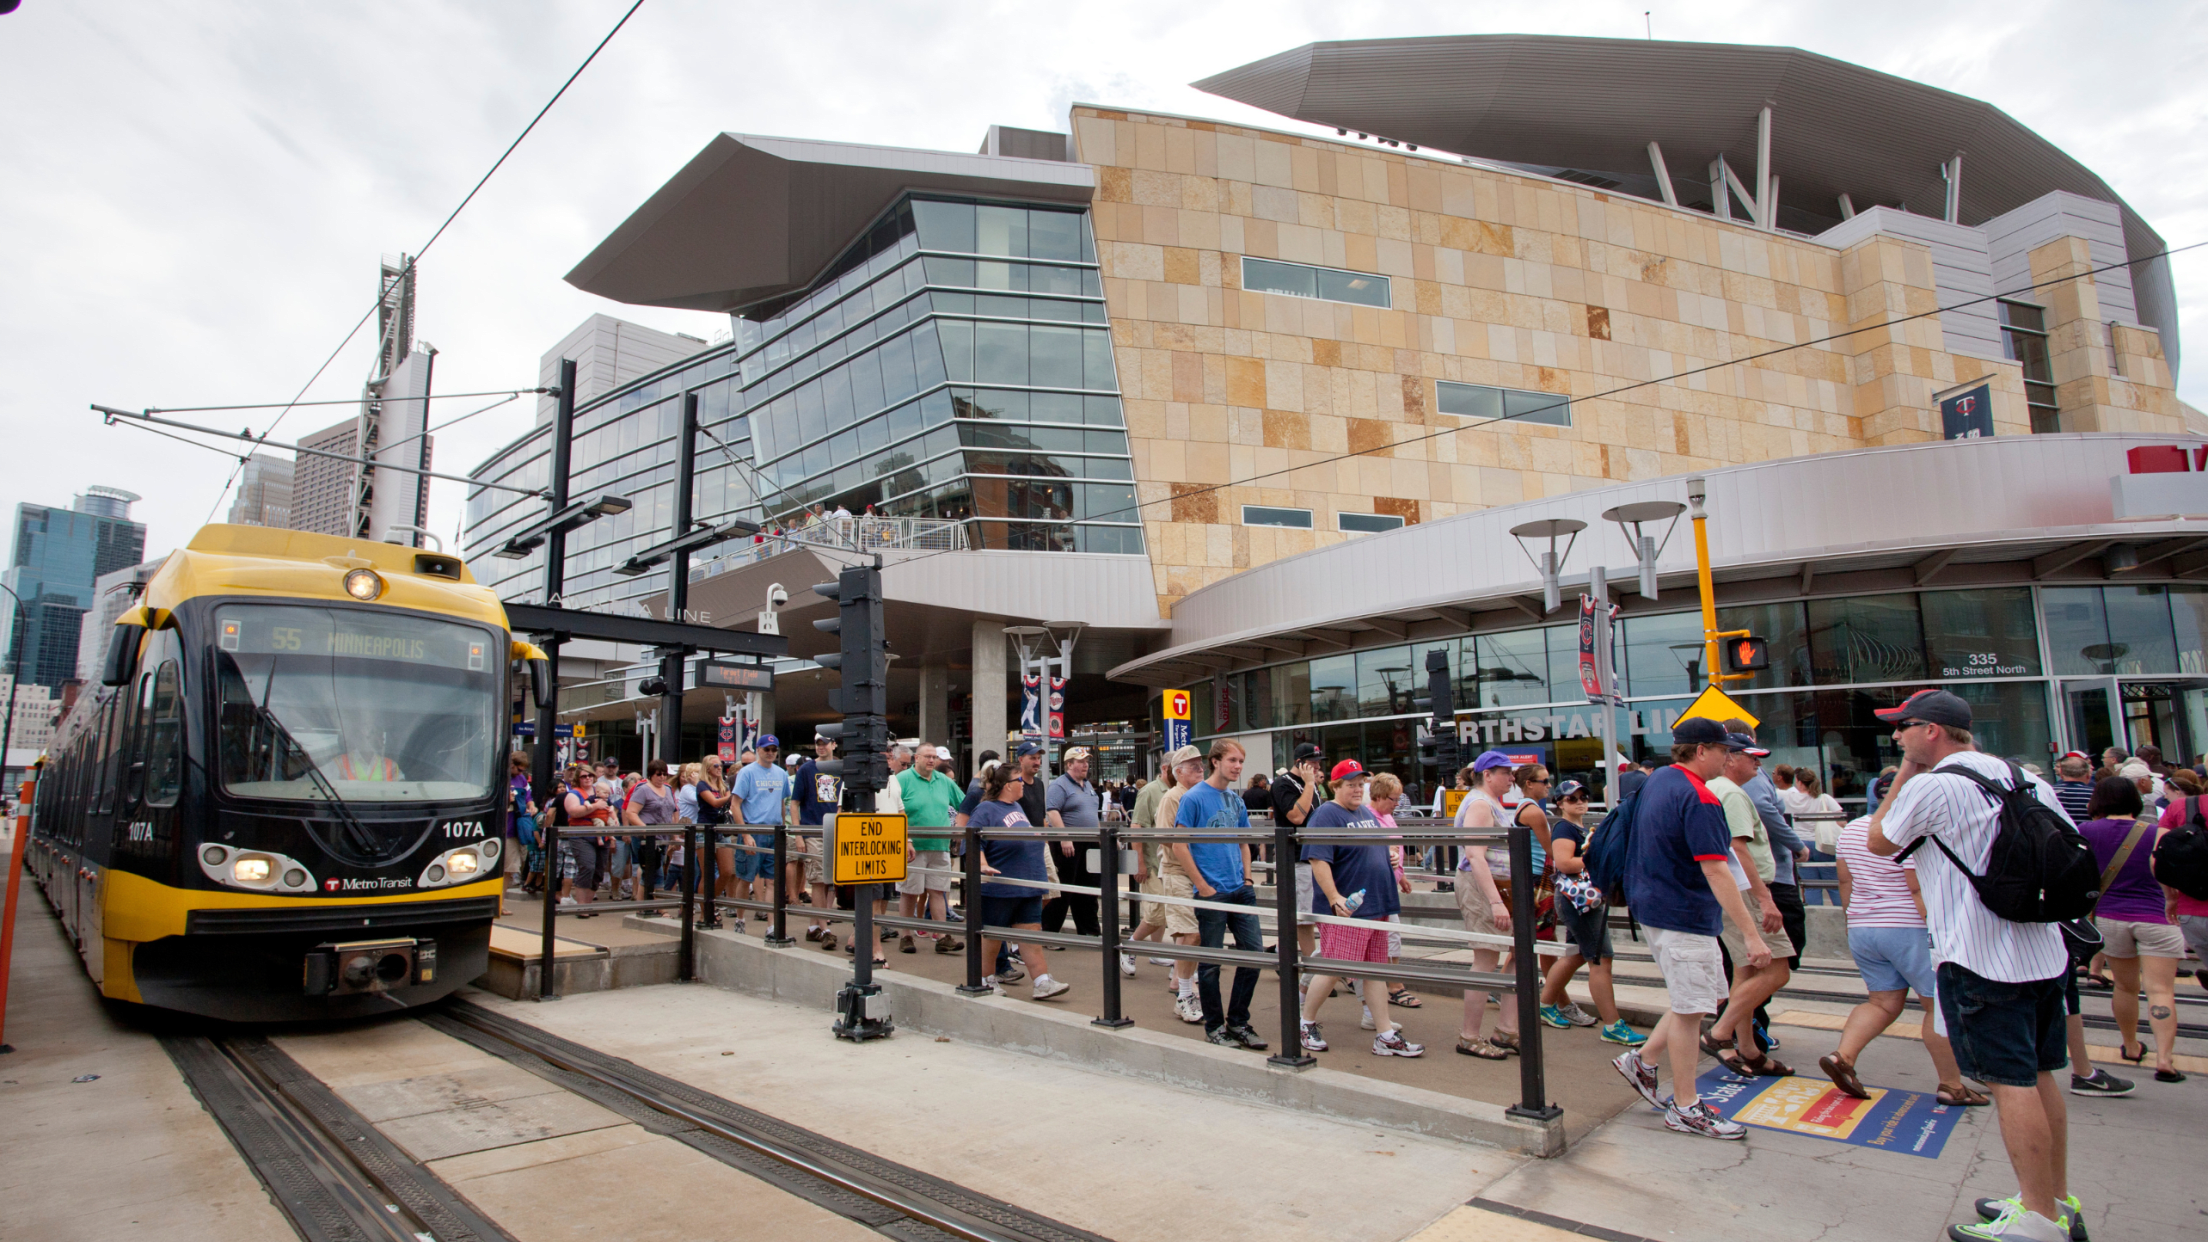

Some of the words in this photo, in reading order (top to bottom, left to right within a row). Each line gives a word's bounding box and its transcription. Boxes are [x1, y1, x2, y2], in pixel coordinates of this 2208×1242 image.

[522, 590, 653, 617] HAWATHA
[664, 606, 711, 624] LINE
[272, 626, 302, 651] 55
[327, 631, 425, 660] MINNEAPOLIS
[1968, 652, 1998, 666] 335
[1942, 666, 1960, 676] 5th
[1962, 665, 1994, 676] Street
[1996, 664, 2026, 674] North
[1180, 724, 1188, 746] Metr
[1416, 713, 1604, 747] NRTHSTA
[128, 821, 153, 841] 107A
[443, 821, 485, 838] 107A
[861, 821, 883, 836] END
[840, 840, 902, 857] INTERLOCKING
[855, 859, 887, 876] LIMITS
[1699, 1082, 1747, 1103] State
